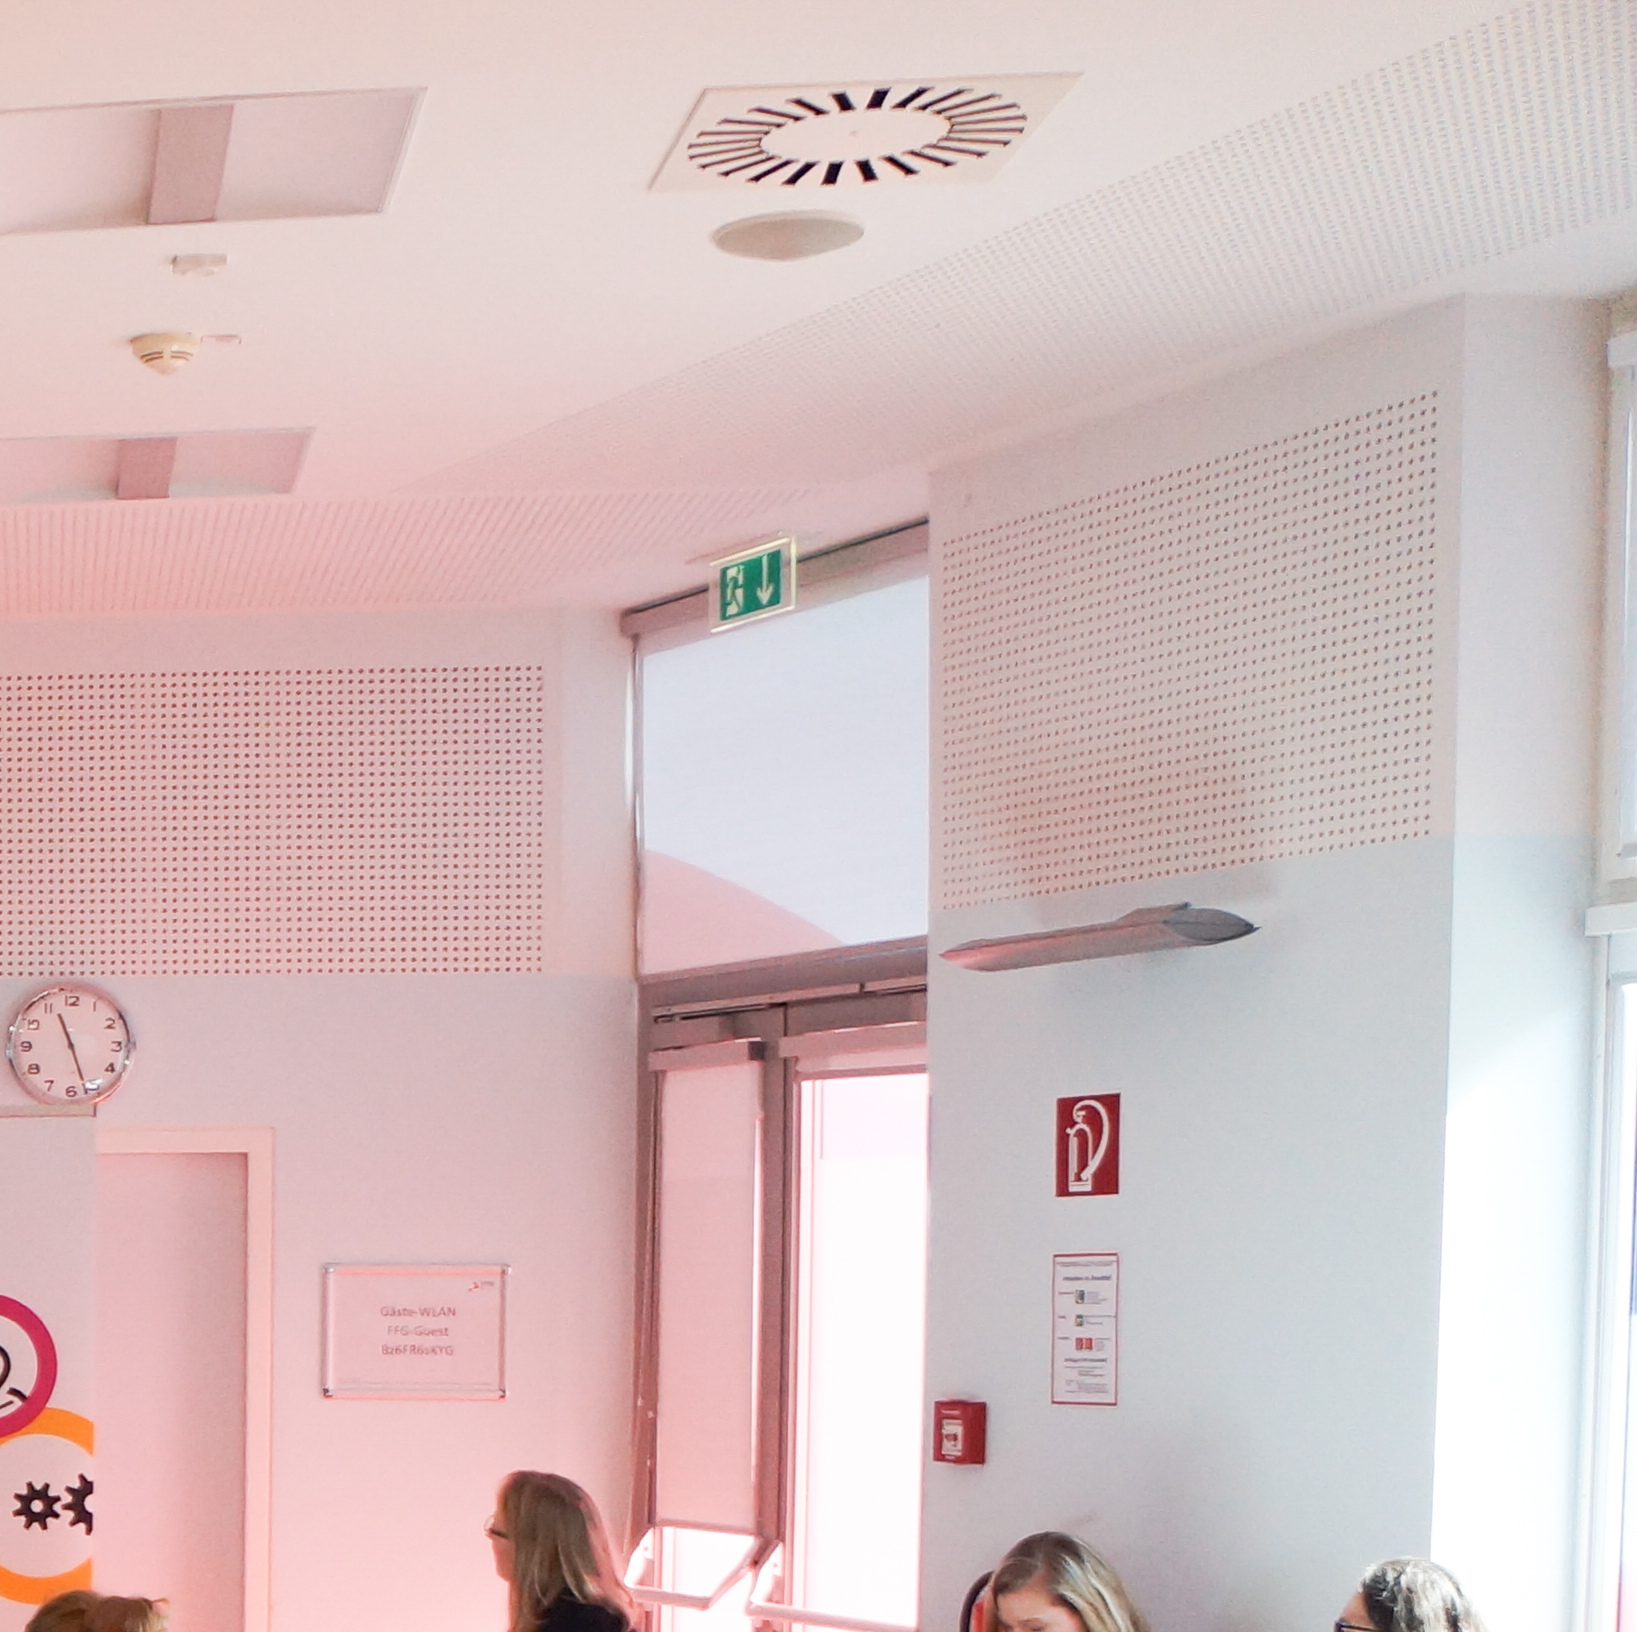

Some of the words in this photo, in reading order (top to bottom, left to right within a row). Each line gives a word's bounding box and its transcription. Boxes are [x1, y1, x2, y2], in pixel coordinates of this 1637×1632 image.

[65, 995, 80, 1007] 12
[44, 1002, 54, 1014] 11
[104, 1017, 116, 1030] 2
[20, 1040, 33, 1053] 9
[110, 1040, 122, 1053] 3
[27, 1063, 41, 1075] 8
[104, 1062, 116, 1074] 4
[44, 1080, 55, 1092] 7
[65, 1086, 78, 1098] 6
